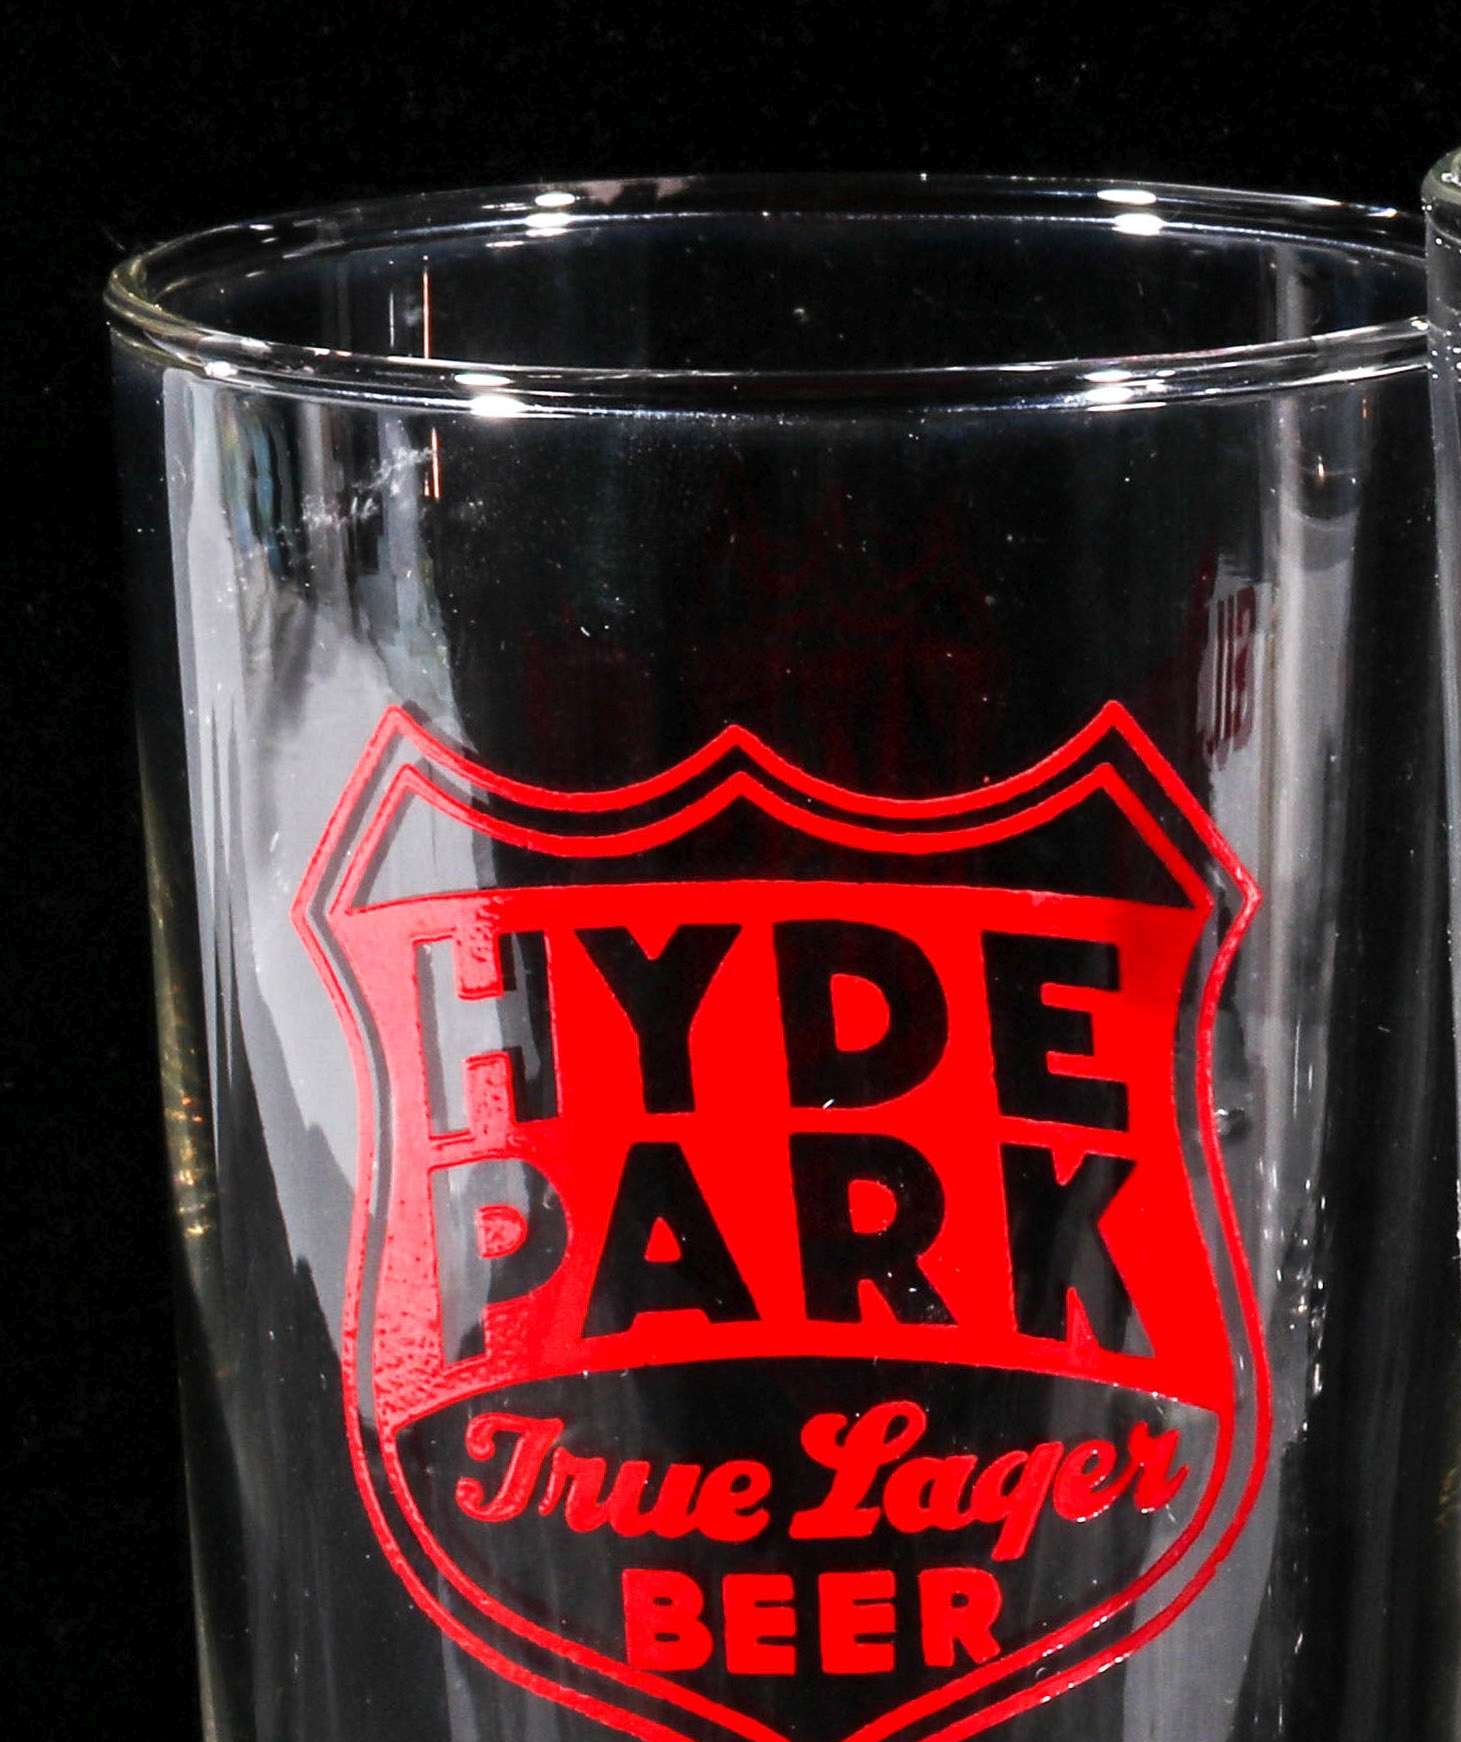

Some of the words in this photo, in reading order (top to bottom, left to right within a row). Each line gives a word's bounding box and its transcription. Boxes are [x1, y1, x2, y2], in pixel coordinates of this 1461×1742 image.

[411, 918, 1130, 1143] HYDE
[431, 1131, 1157, 1367] PARK
[454, 1410, 774, 1545] True
[791, 1401, 1192, 1561] Lager
[622, 1566, 1003, 1677] BEER
